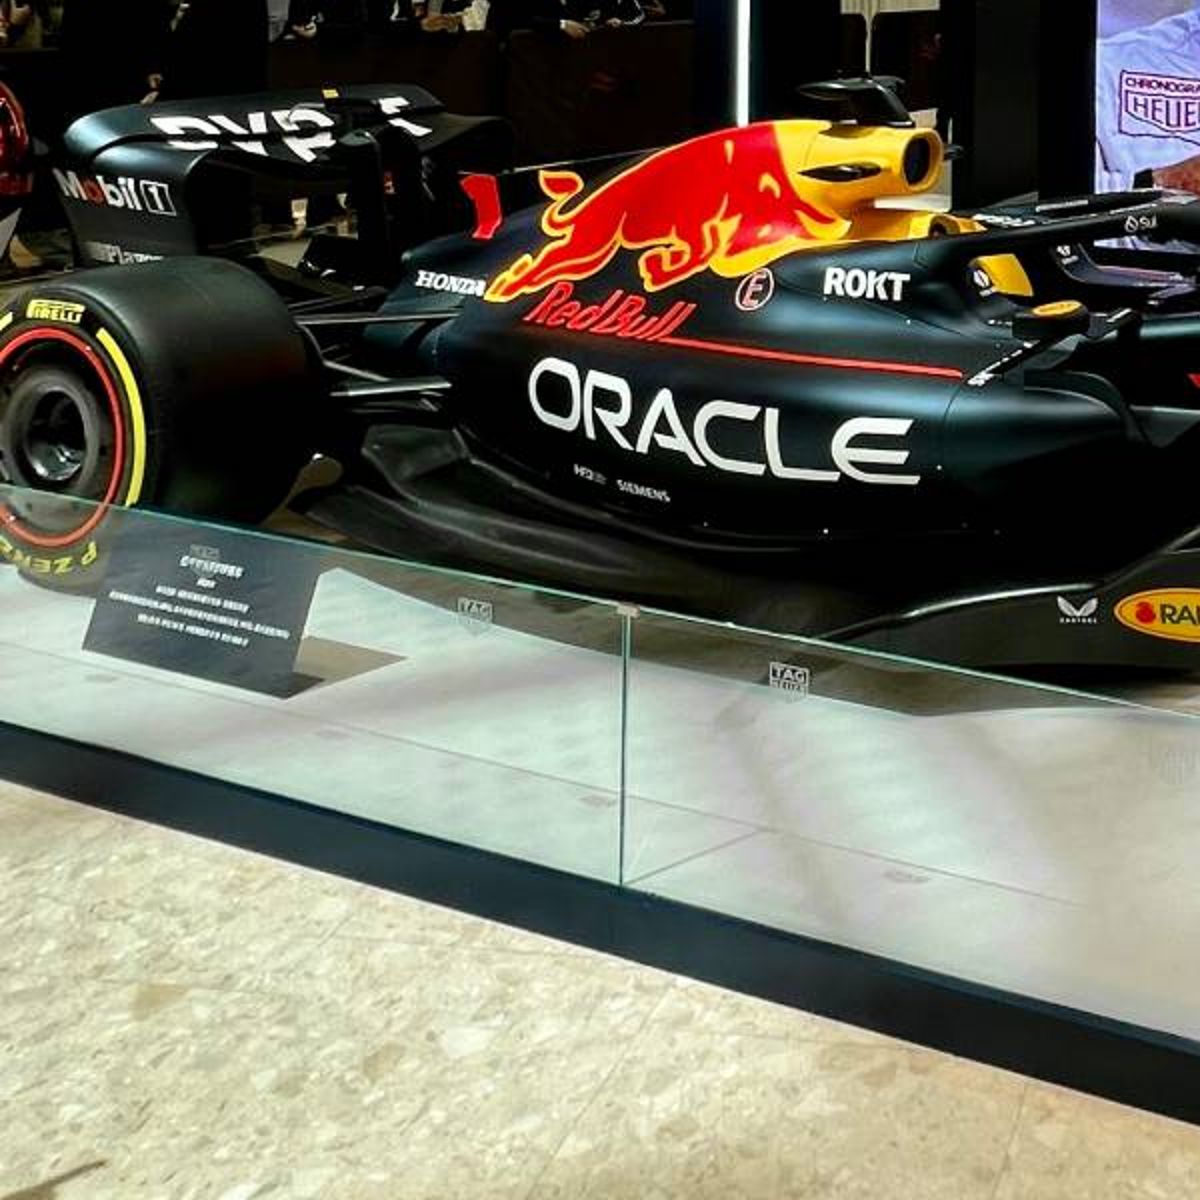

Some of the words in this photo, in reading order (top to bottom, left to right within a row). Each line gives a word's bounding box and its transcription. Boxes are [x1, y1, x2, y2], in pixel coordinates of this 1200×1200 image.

[52, 167, 143, 211] Mobil
[415, 269, 487, 297] HONDA
[823, 267, 911, 301] ROKT
[26, 299, 86, 324] PIRELLI
[527, 357, 920, 486] ORACLE
[616, 479, 671, 502] SIEMENS
[772, 665, 806, 682] TAG
